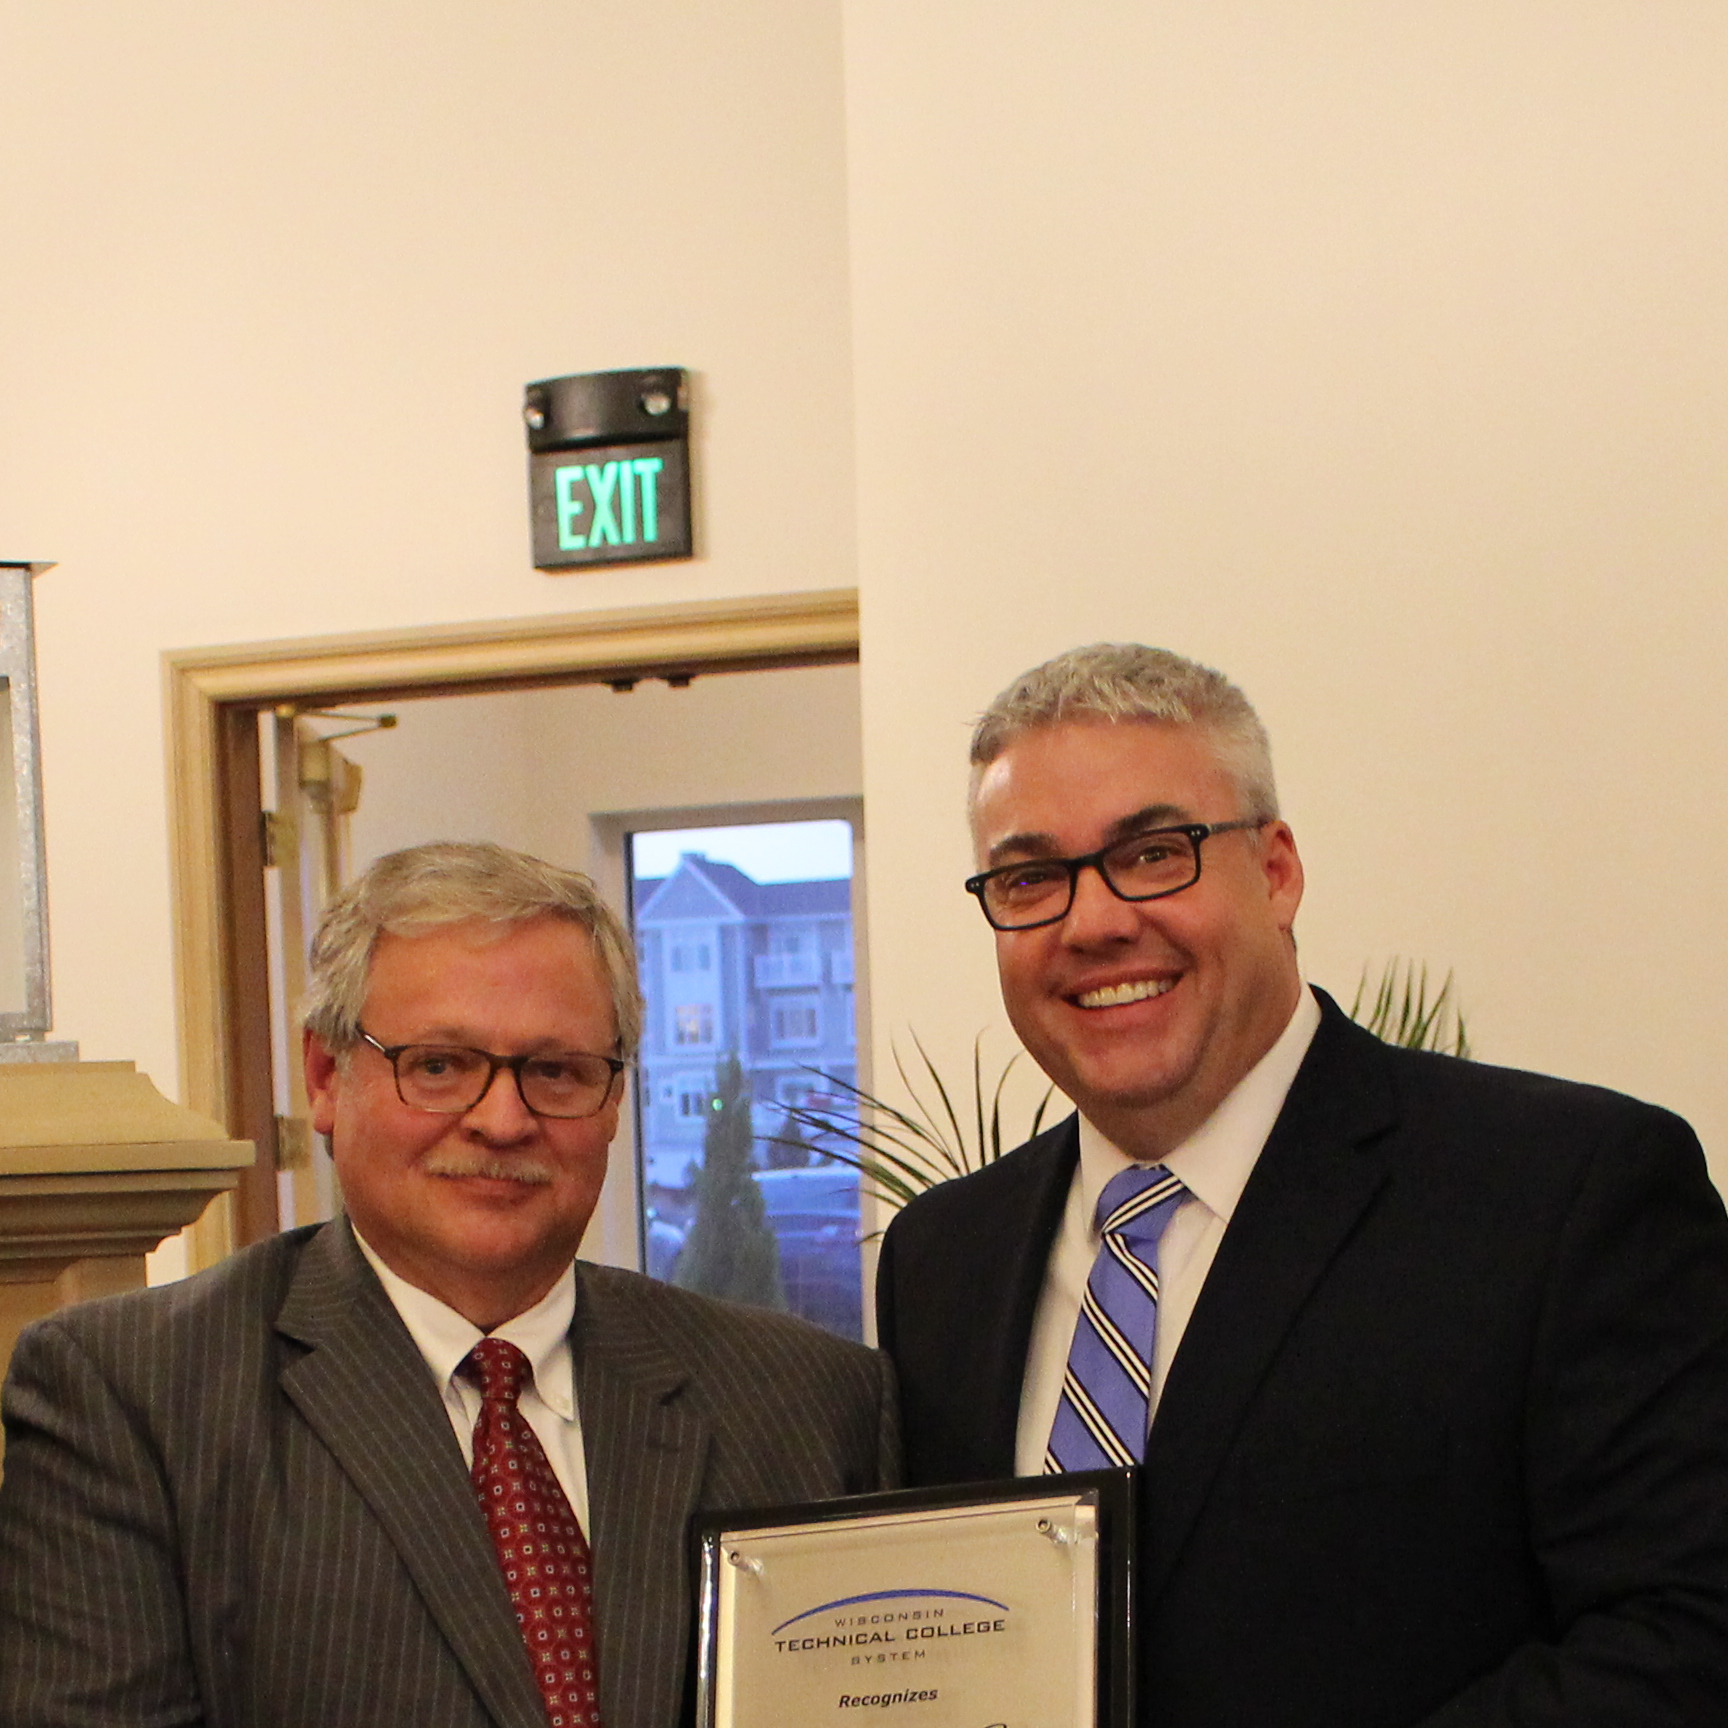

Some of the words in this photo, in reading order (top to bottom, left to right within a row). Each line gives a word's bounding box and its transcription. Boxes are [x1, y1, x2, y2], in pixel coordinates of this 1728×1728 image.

[555, 457, 664, 551] EXIT
[835, 1608, 944, 1627] WISCONSIN
[774, 1631, 896, 1652] TECHNICAL
[906, 1619, 1005, 1640] COLLEGE
[851, 1650, 926, 1665] SYSTEM
[839, 1688, 938, 1708] Recognizes
